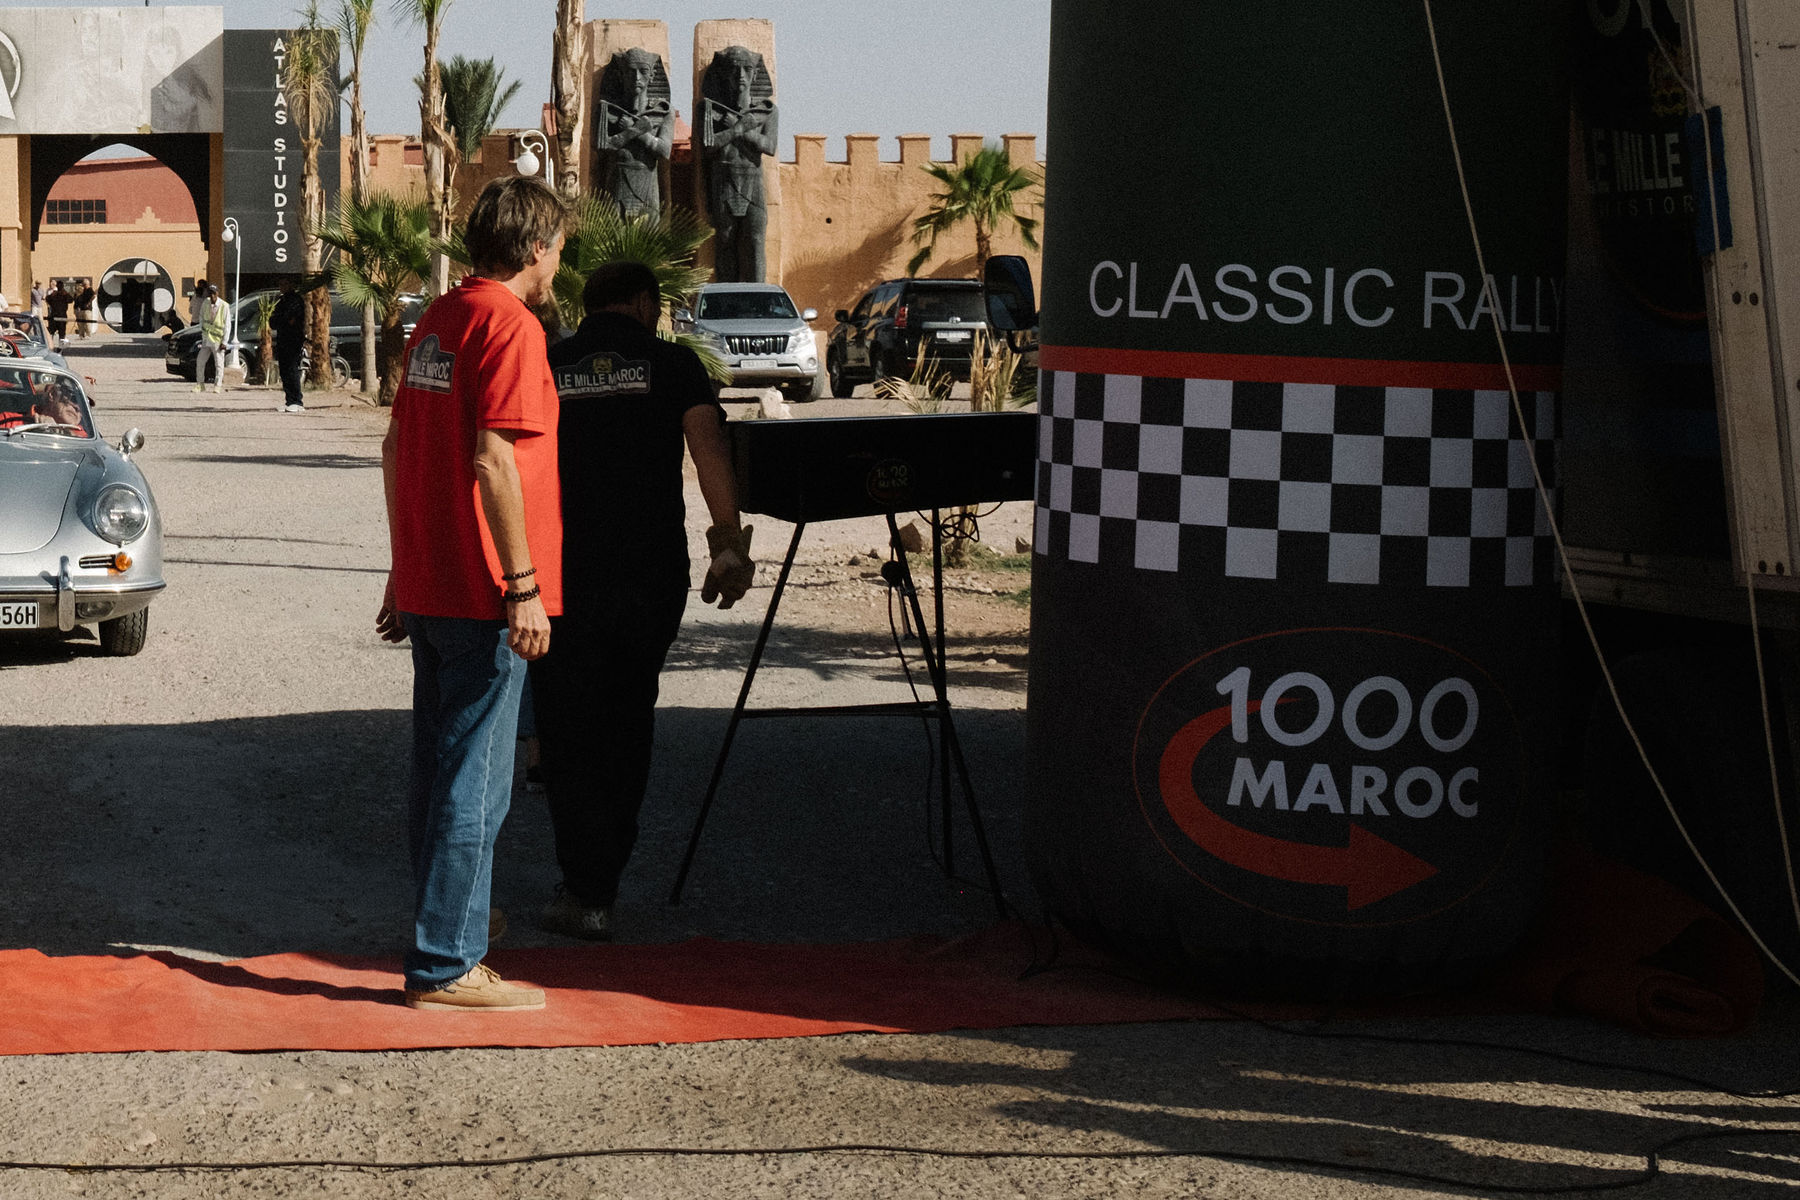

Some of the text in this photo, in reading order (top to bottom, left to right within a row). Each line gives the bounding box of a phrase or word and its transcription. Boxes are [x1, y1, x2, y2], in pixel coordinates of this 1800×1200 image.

[273, 37, 288, 263] ATLAS STUDIOS
[1089, 260, 1564, 333] CLASSIC RALLY
[558, 366, 645, 389] LE MILLE MAROC
[1216, 666, 1480, 753] 1000
[1226, 757, 1480, 818] MAROC
